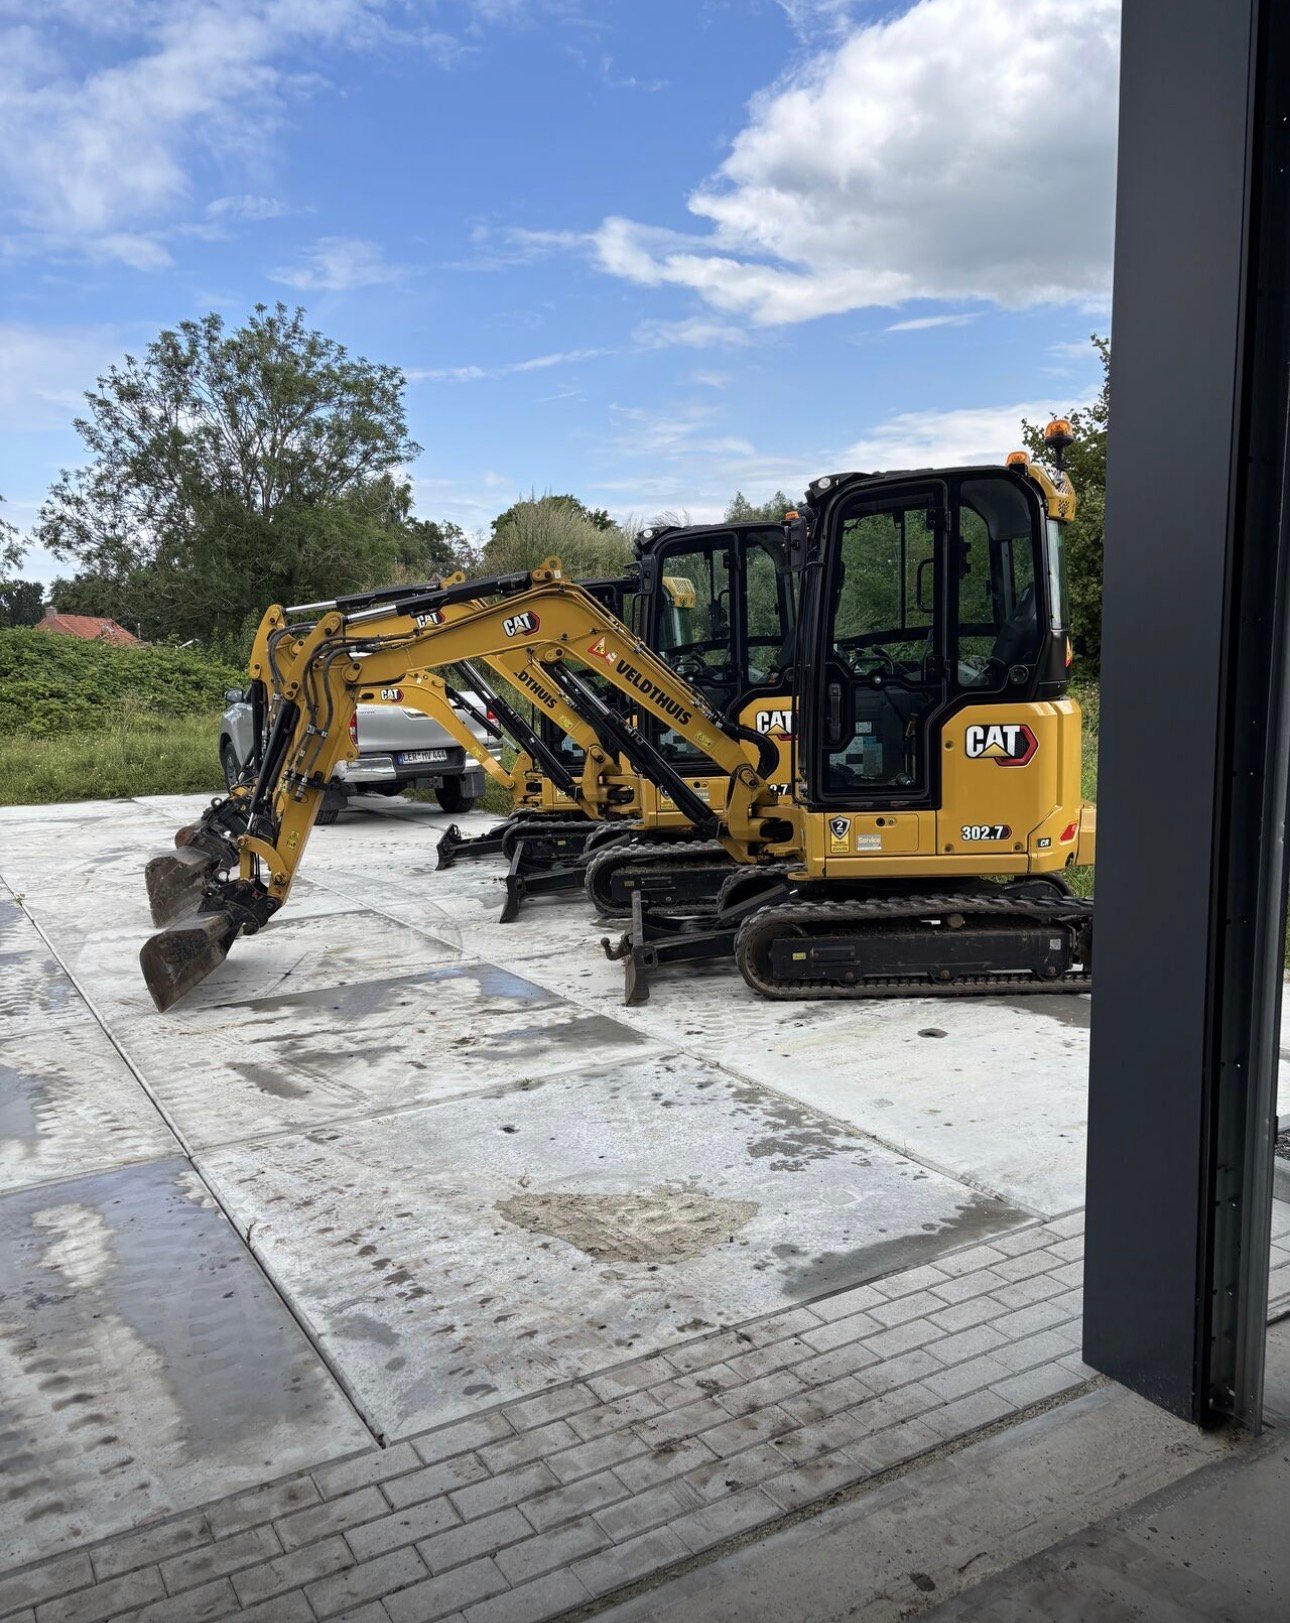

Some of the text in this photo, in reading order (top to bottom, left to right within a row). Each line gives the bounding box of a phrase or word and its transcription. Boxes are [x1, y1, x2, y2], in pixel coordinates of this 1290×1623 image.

[416, 612, 439, 629] CAT
[503, 612, 532, 637] CAT
[381, 689, 398, 700] CAT
[513, 670, 557, 709] DTHUIS
[616, 659, 692, 725] VELDTHUIS
[756, 711, 792, 735] CAT
[966, 725, 1020, 758] CAT
[836, 820, 844, 830] 2
[962, 826, 1004, 840] 302.7
